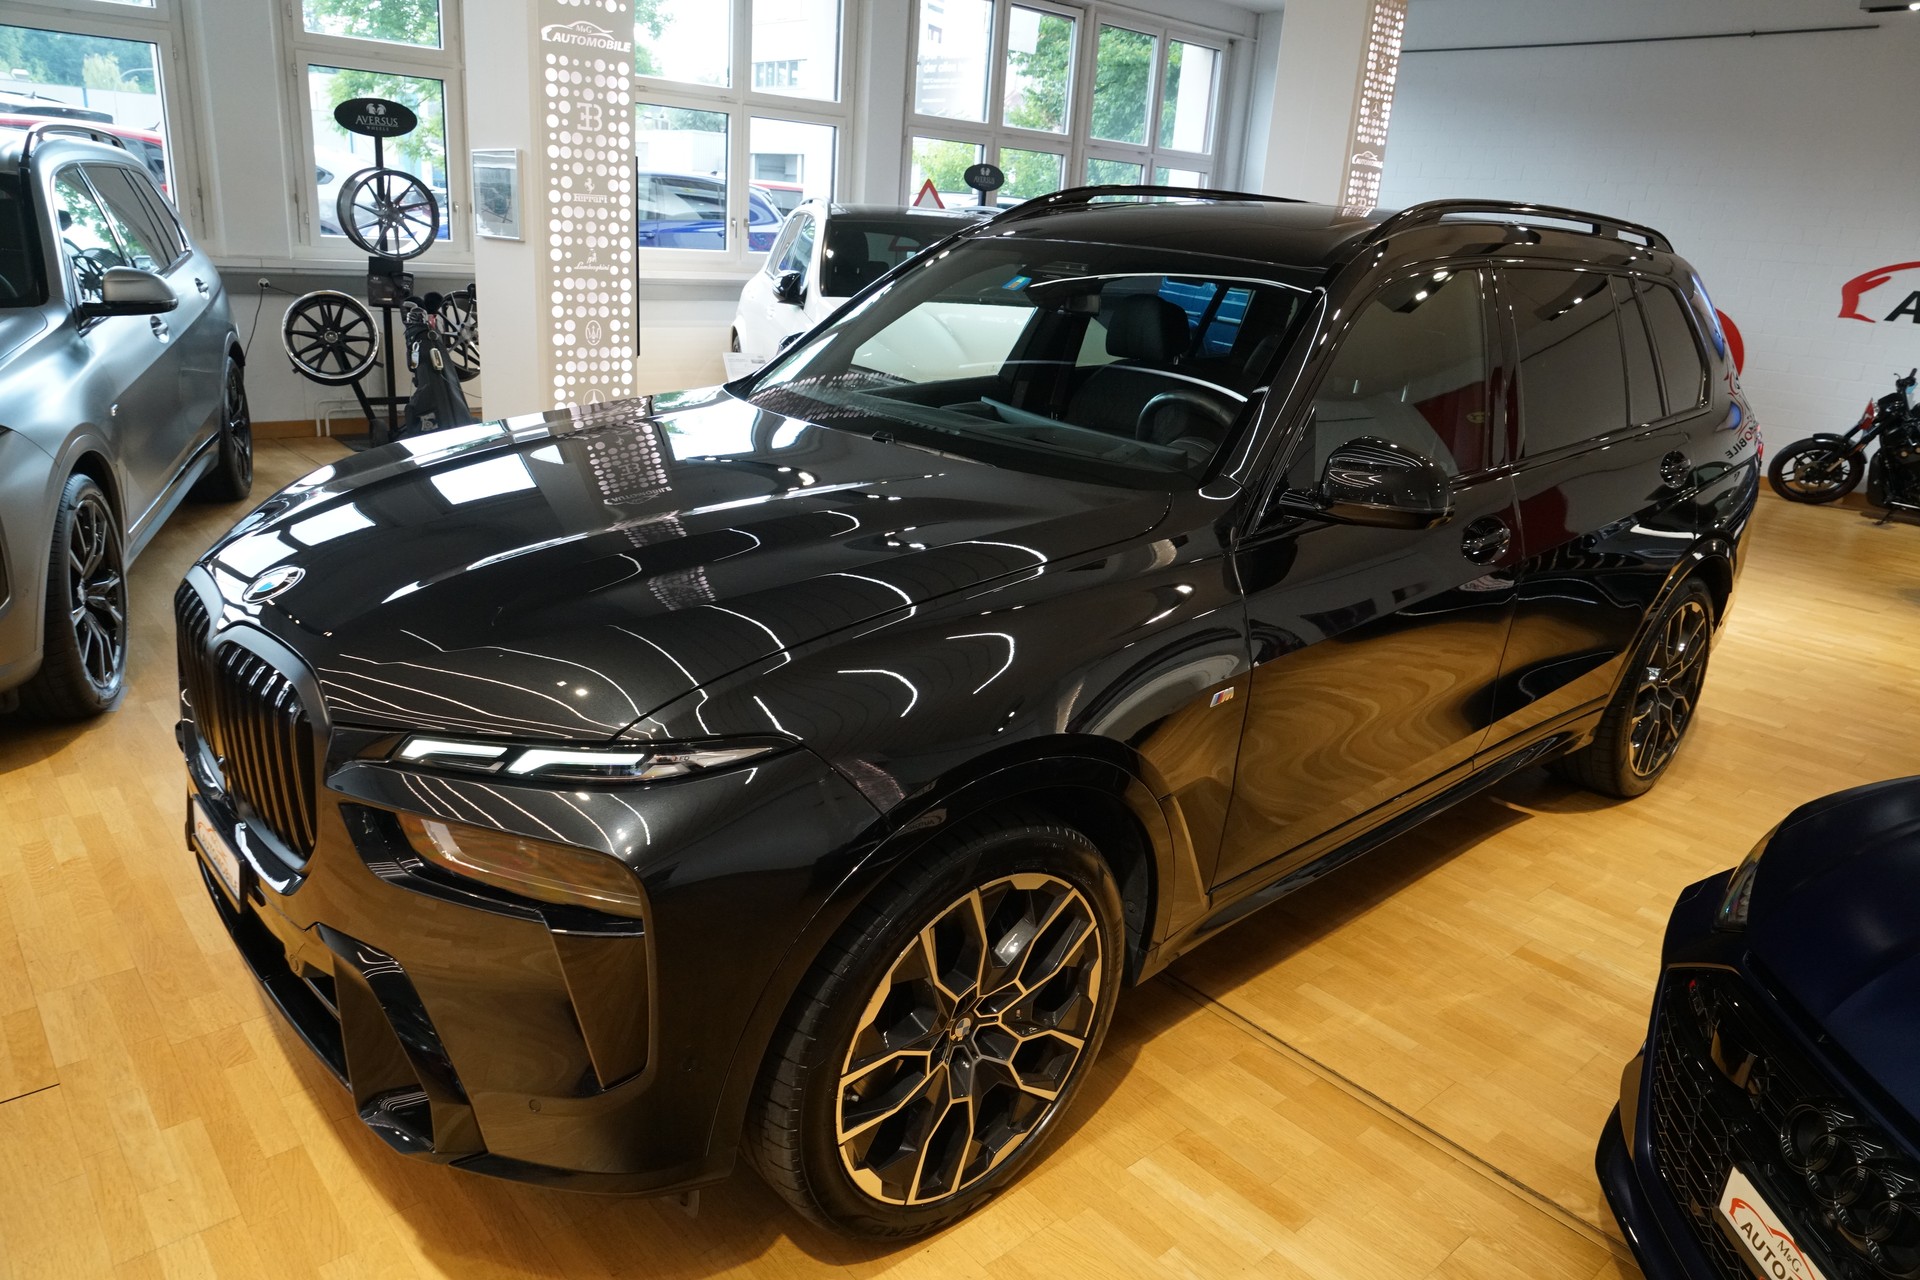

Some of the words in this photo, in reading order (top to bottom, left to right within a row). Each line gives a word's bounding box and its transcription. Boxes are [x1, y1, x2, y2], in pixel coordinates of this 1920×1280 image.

[552, 32, 631, 53] AUTOMOBILE
[355, 115, 398, 127] AVERSUS
[573, 193, 608, 204] Ferrari
[1740, 1222, 1794, 1280] AUTO
[1777, 1240, 1803, 1272] M&G
